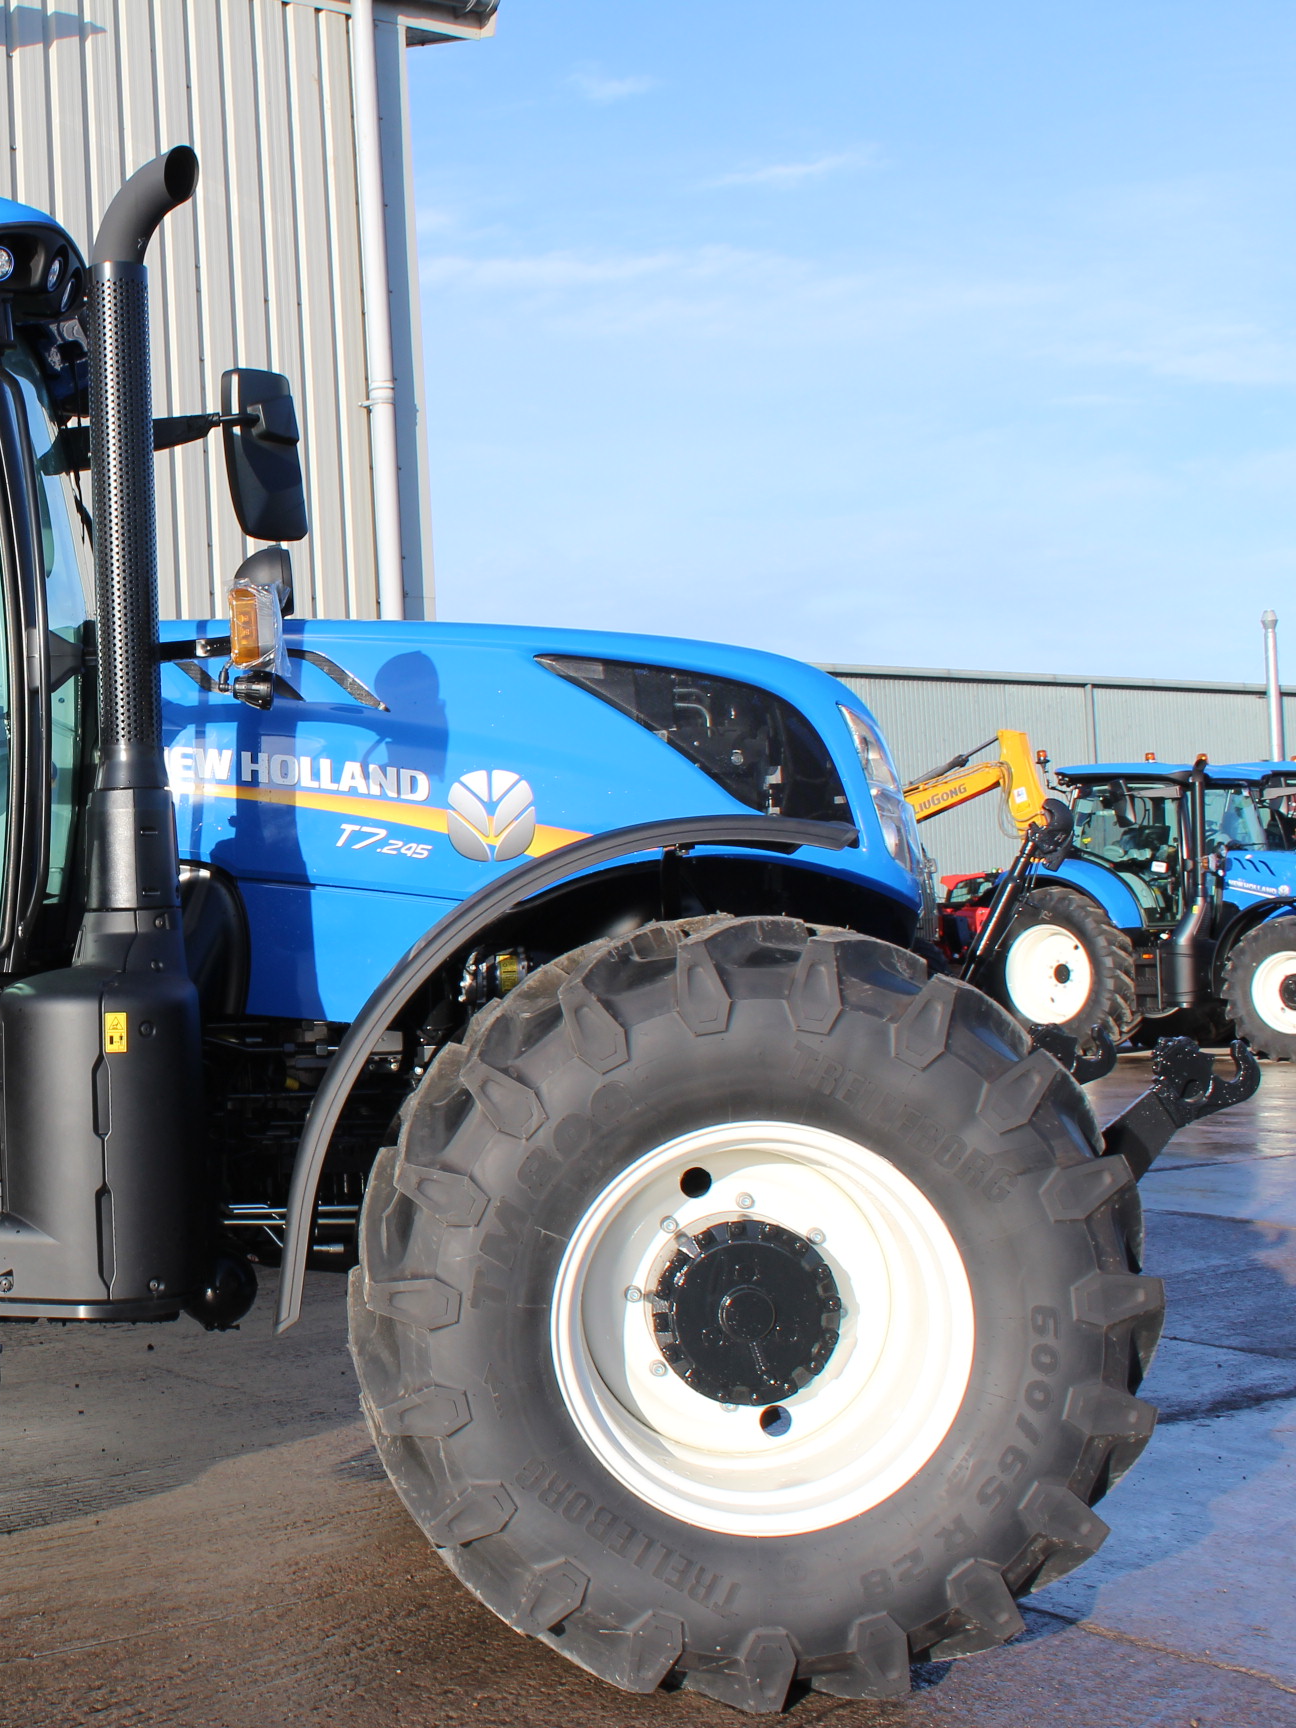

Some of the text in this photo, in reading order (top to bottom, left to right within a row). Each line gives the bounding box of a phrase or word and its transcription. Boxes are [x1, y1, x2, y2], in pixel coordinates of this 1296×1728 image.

[164, 746, 431, 802] EW HOLLAND
[335, 823, 433, 860] T7.245
[1244, 882, 1278, 895] HOLLAND
[786, 1039, 1021, 1204] TRELLEBORG
[975, 1304, 1061, 1516] 600/65
[514, 1457, 743, 1619] TRELLEBORG
[934, 1513, 978, 1556] R
[859, 1546, 929, 1601] 28
